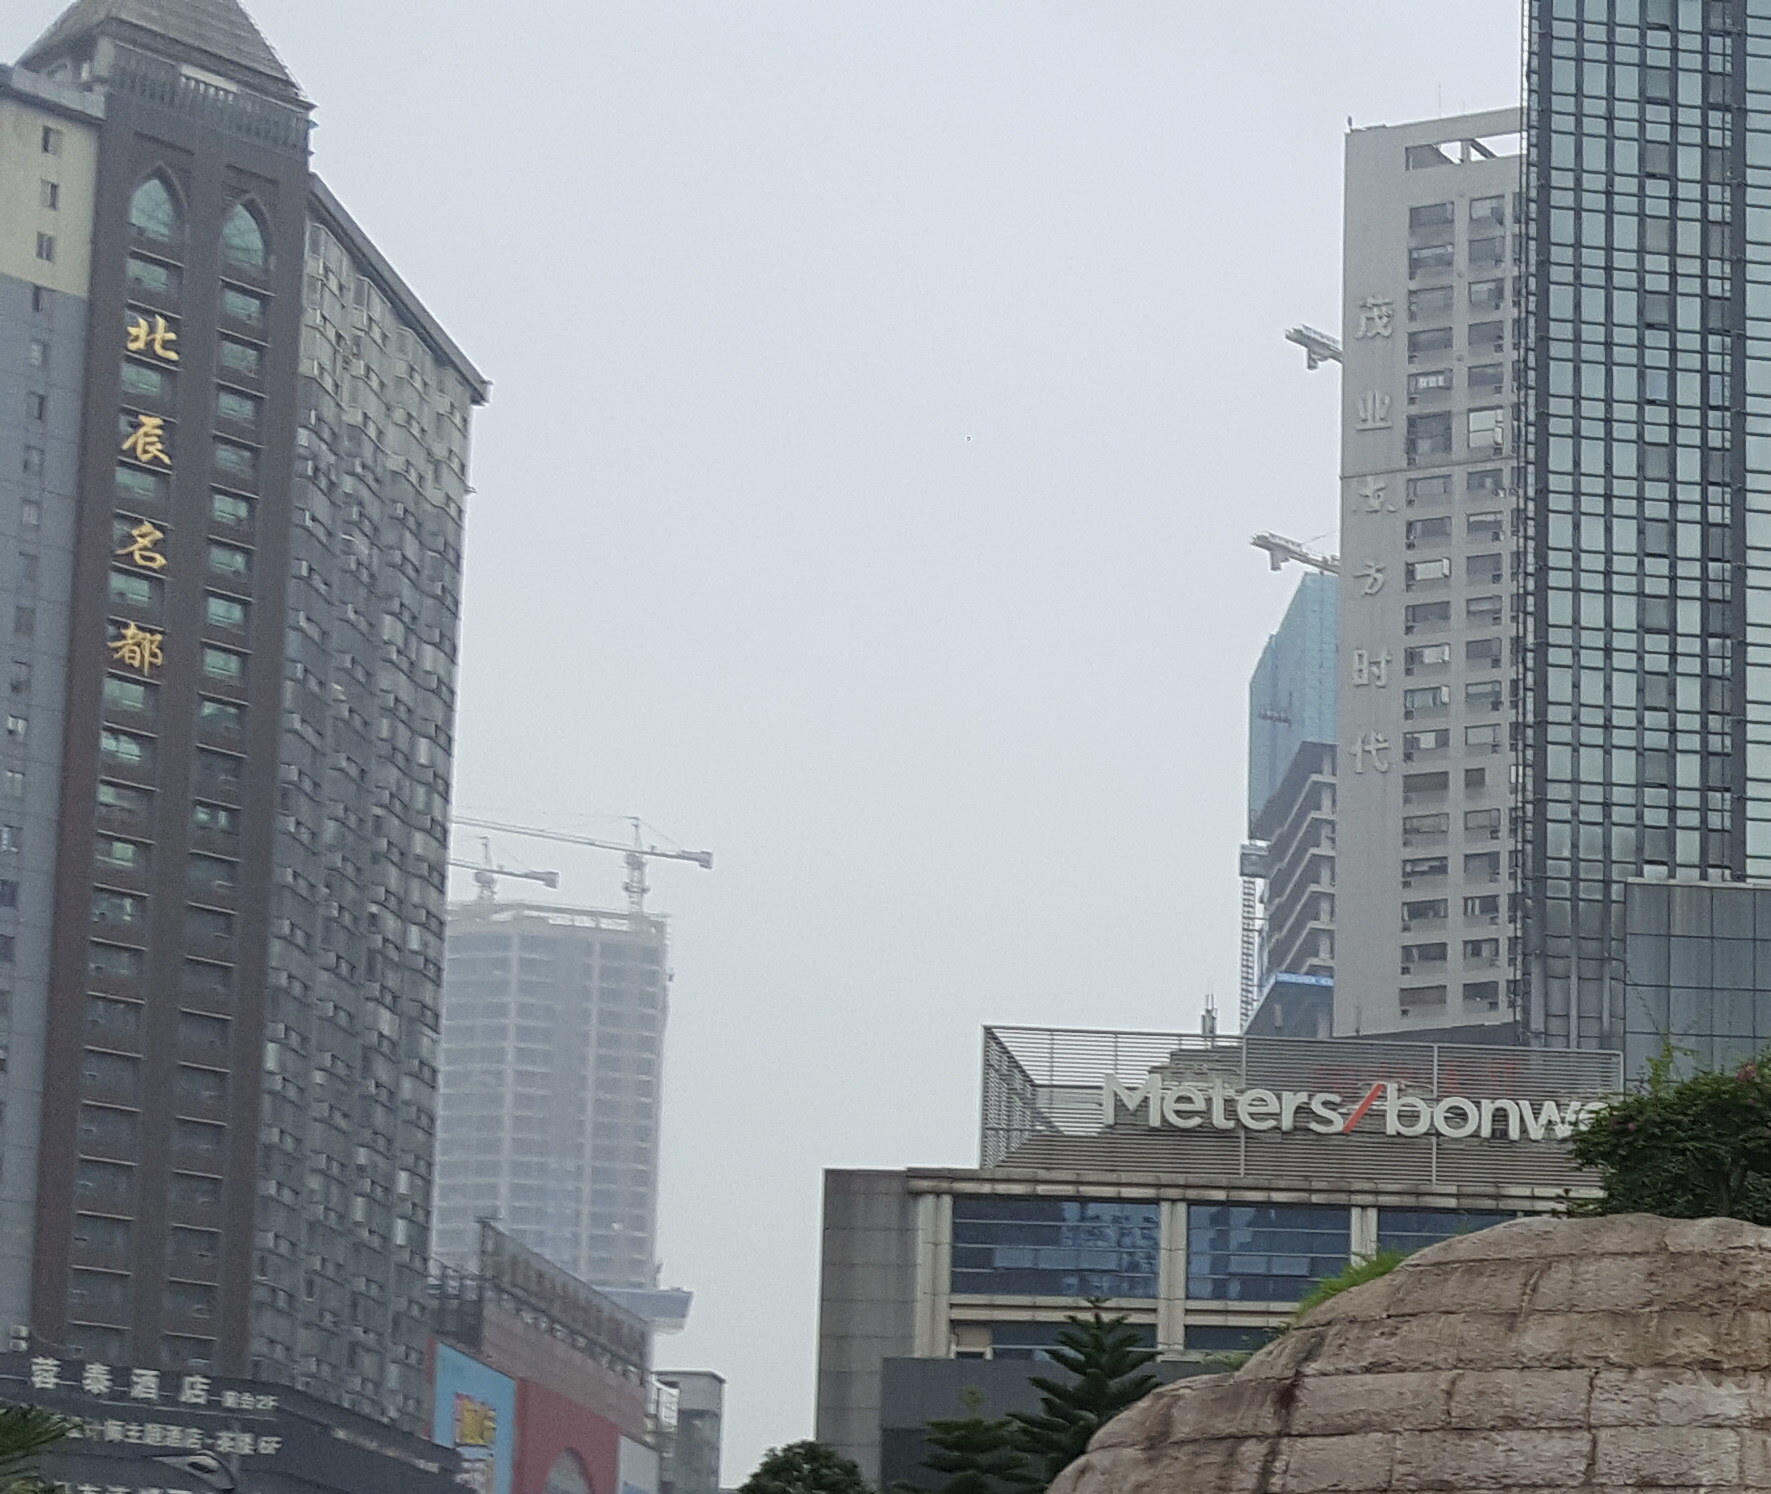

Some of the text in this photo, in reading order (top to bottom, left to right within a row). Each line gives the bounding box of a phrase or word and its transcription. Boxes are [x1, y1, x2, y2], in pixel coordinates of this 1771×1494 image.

[107, 315, 180, 673] 北辰名都
[1351, 294, 1395, 776] 茂业东方时代
